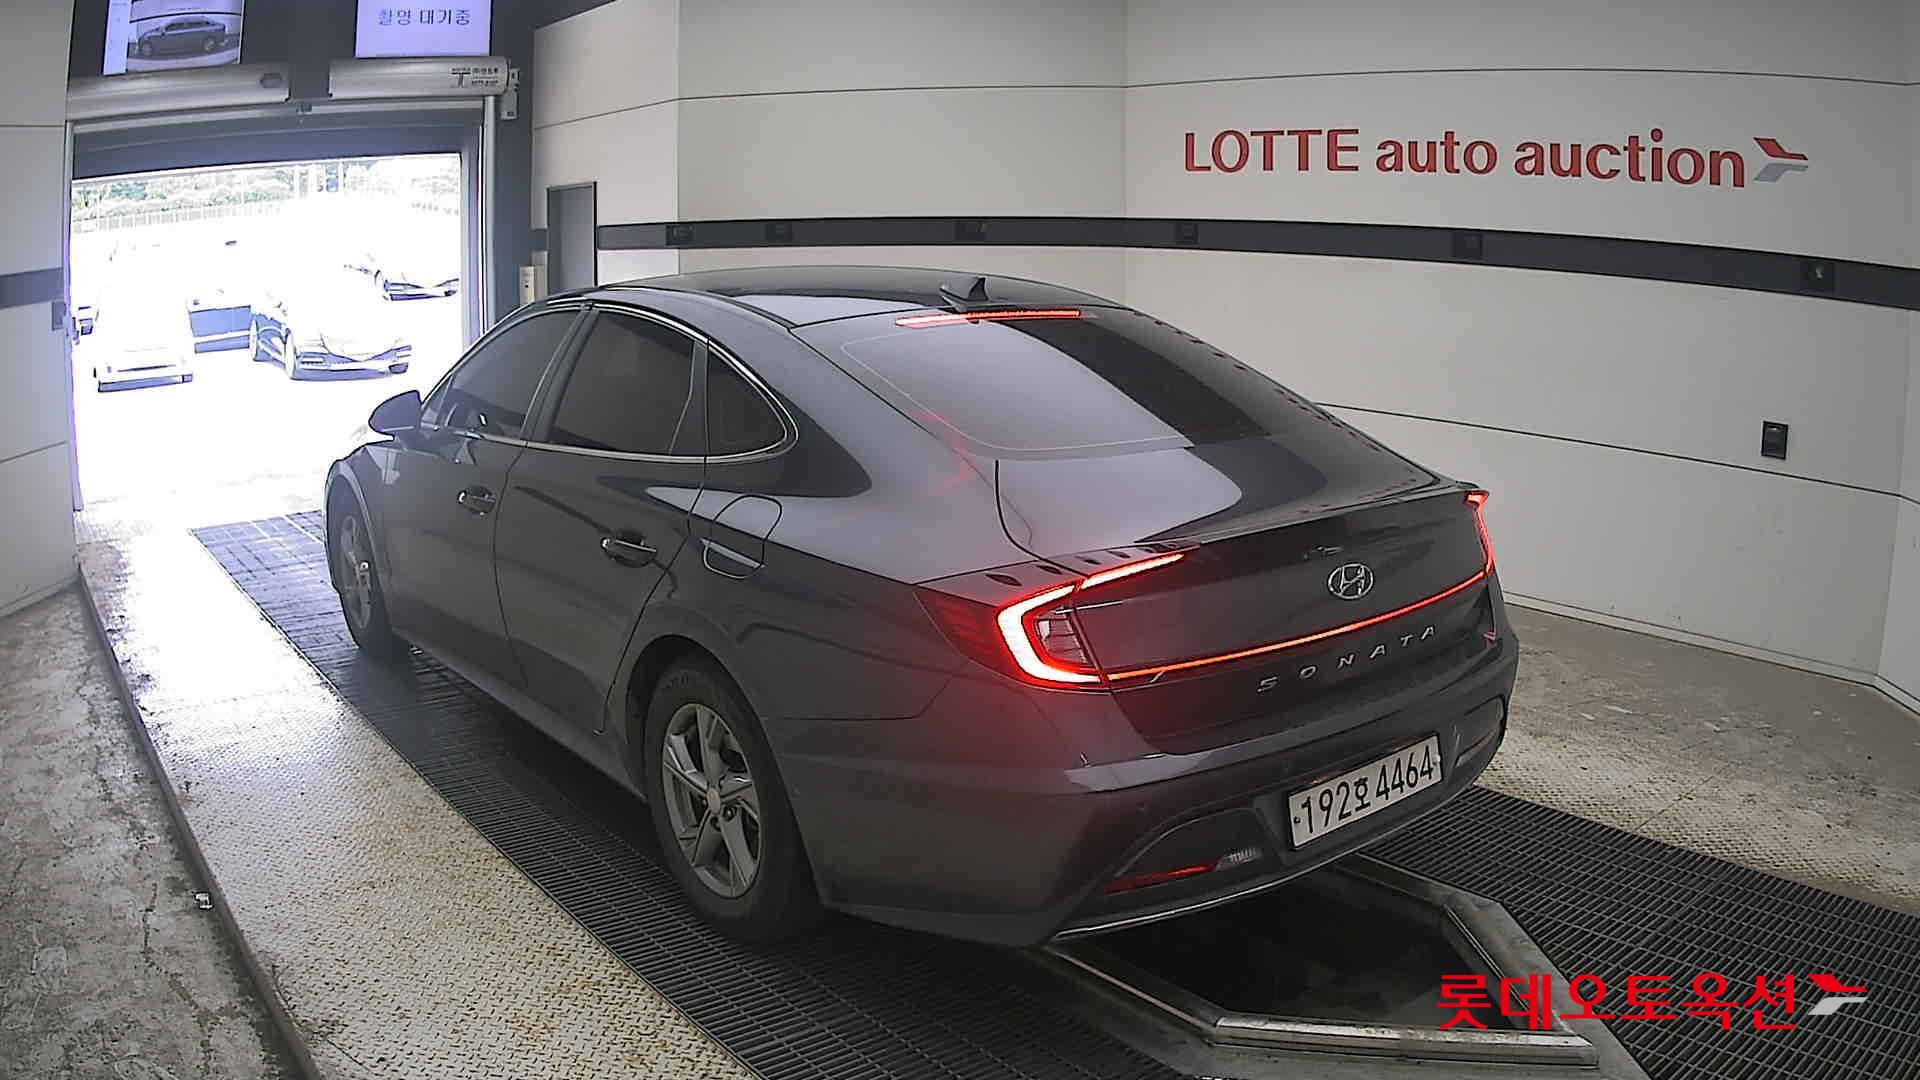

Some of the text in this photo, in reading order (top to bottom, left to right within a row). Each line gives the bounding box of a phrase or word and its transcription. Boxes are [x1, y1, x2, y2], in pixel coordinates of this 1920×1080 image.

[419, 9, 471, 26] 대기중
[1184, 127, 1746, 188] LOTTE auto auction
[1257, 625, 1436, 693] SONATA
[1301, 745, 1434, 834] 192호 4464
